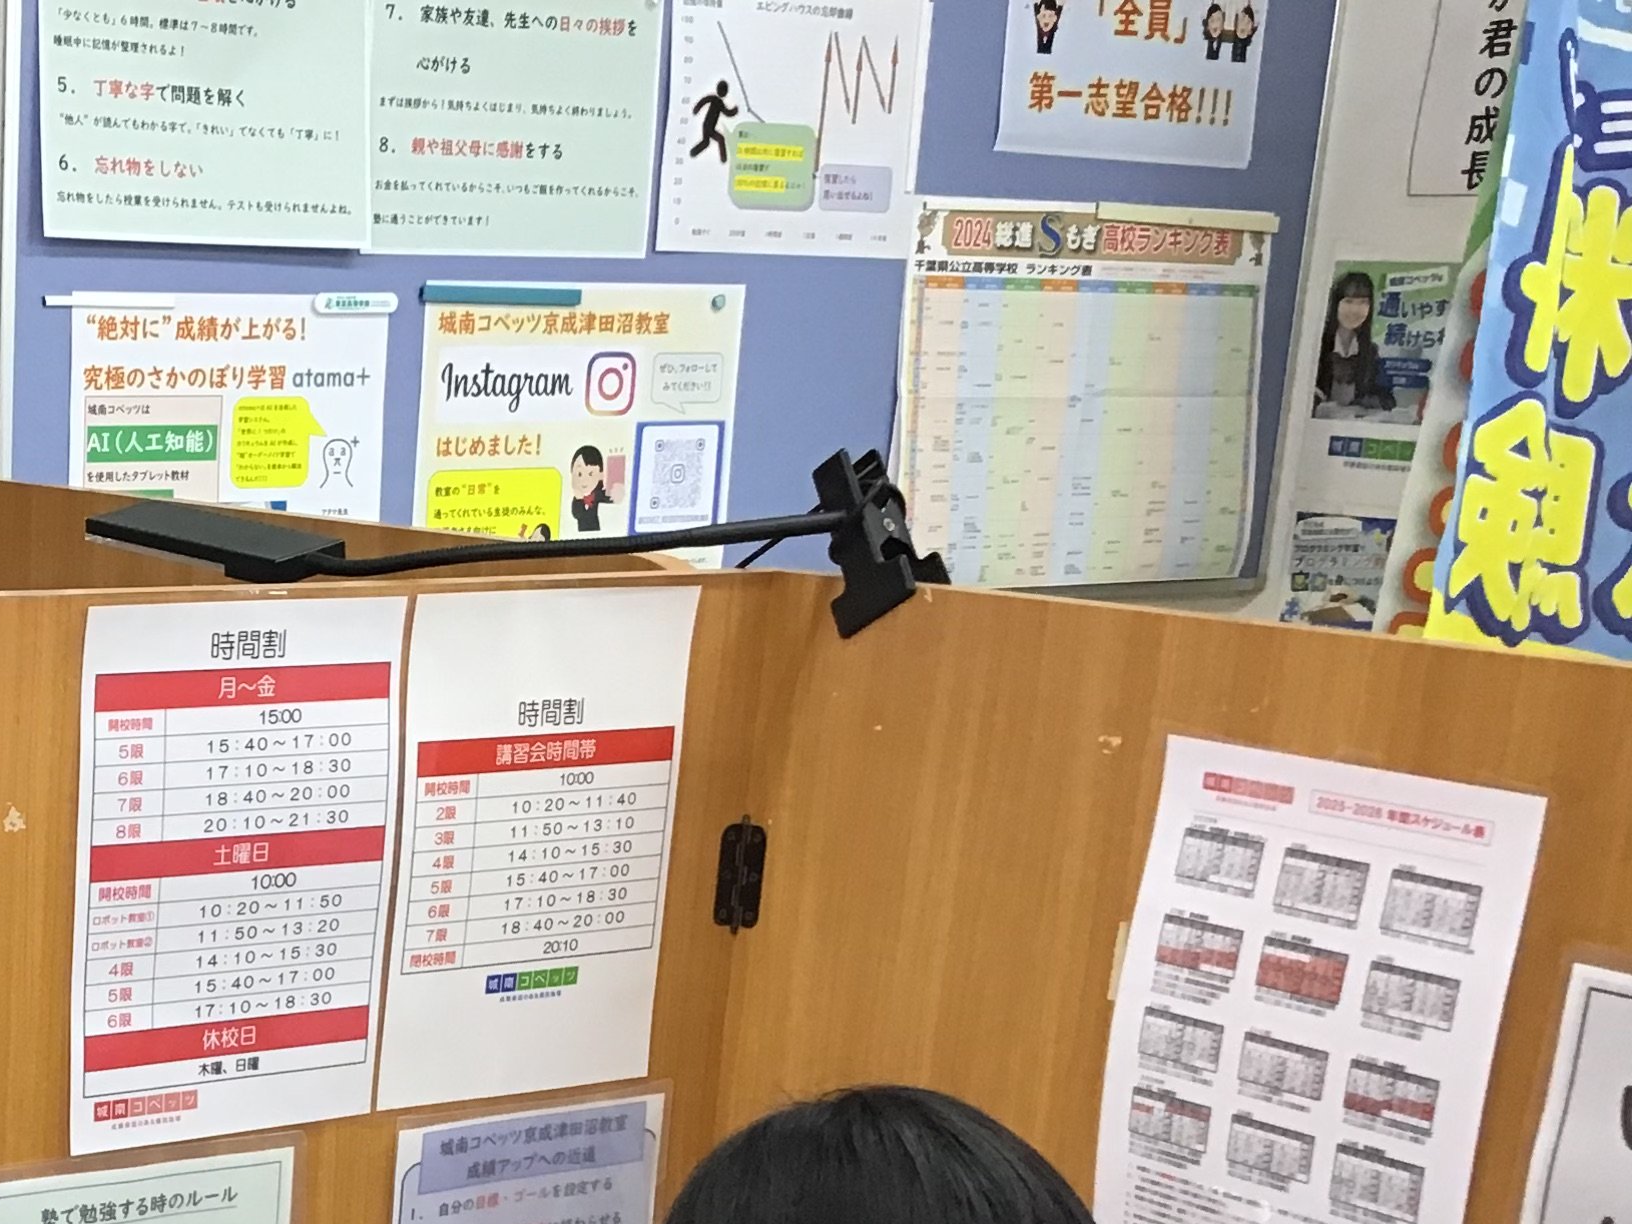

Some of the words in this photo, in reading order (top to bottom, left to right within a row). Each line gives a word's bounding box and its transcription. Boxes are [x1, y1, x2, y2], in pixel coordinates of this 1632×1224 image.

[420, 5, 637, 37] 家族や友達、先生への日々の挨拶を
[416, 56, 471, 75] 心がける
[94, 79, 246, 107] 丁寧な字で問題を解く
[1461, 0, 1518, 190] 君の成長
[411, 137, 563, 160] 親や祖父母に感謝をする
[94, 155, 204, 178] 忘れ物をしない
[438, 310, 671, 336] 城南コベッツ京成津田沼教室
[83, 364, 286, 391] 究極のさかのぼり学習
[292, 367, 371, 389] atama+
[440, 361, 574, 414] Instagram
[87, 403, 151, 416] 城南コベッツは
[86, 469, 190, 483] を使用したタブレット教材
[210, 629, 288, 661] 時間割
[218, 674, 276, 699] 月～金
[107, 717, 153, 732] 開校時間
[259, 707, 303, 726] 15:00
[517, 696, 585, 727] 時間割
[118, 743, 144, 759] 5限
[495, 739, 597, 766] 講習会時間帯
[117, 769, 143, 786] 6限
[424, 780, 471, 797] 開校時間
[117, 796, 142, 813] 7限
[435, 805, 457, 821] 2限
[115, 823, 141, 840] 8限
[433, 830, 455, 846] 3限
[213, 842, 269, 866] 土曜日
[432, 854, 455, 870] 4限
[97, 883, 152, 901] 開校時間
[251, 872, 297, 891] 10:00
[430, 879, 453, 894] 5限
[427, 903, 450, 919] 6限
[425, 928, 448, 943] 7限
[108, 961, 134, 977] 4限
[486, 967, 578, 994] 城南コベッツ
[107, 986, 133, 1003] 5限
[106, 1012, 132, 1029] 6限
[202, 1025, 257, 1050] 休校日
[197, 1056, 260, 1076] 木曜、日曜
[95, 1091, 197, 1121] 城南コベッツ
[439, 1113, 629, 1157] 城南コベッツ京成津田沼教室
[467, 1145, 597, 1180] 成績アップへの近道
